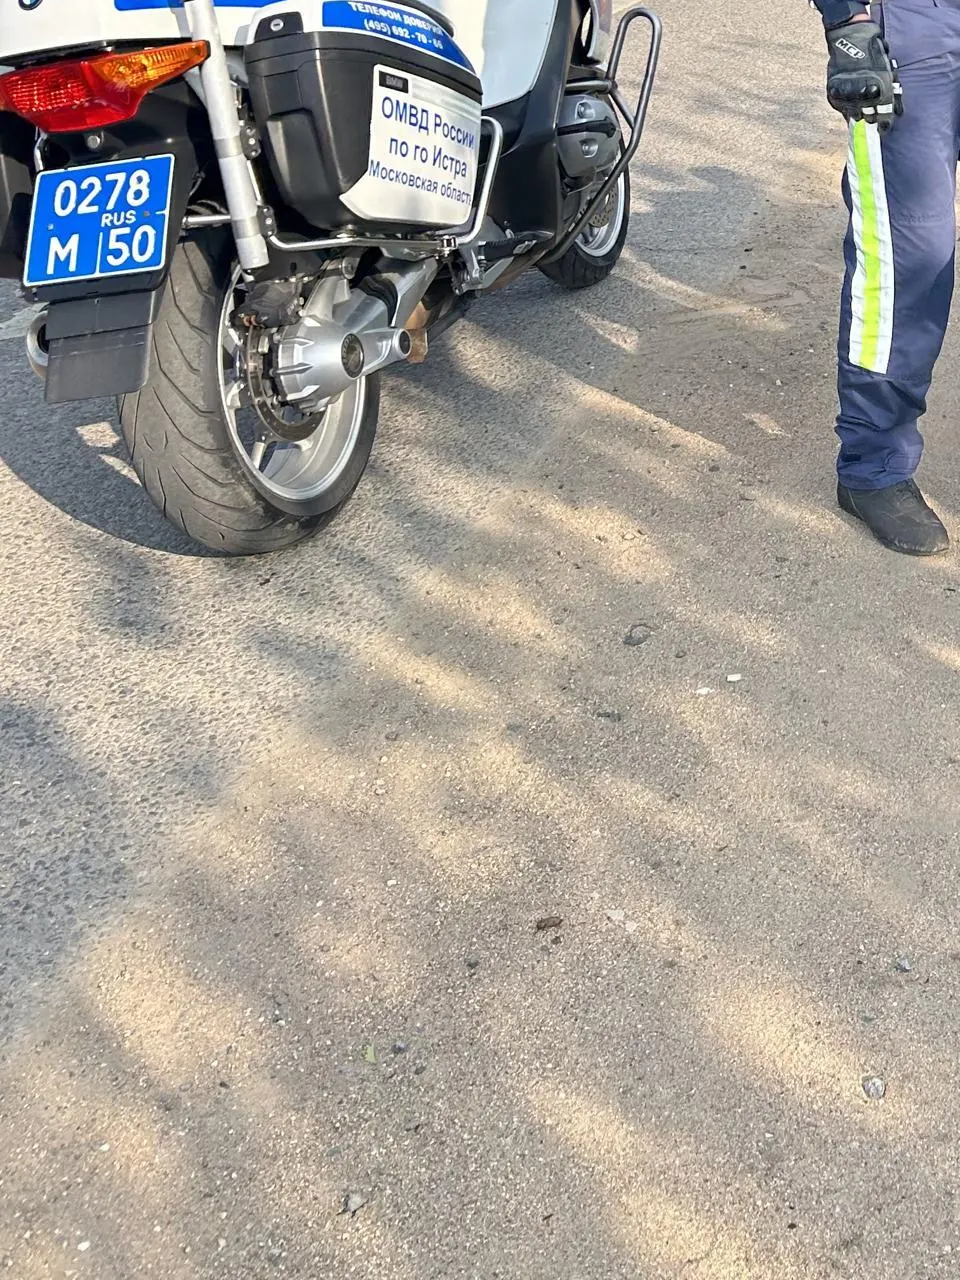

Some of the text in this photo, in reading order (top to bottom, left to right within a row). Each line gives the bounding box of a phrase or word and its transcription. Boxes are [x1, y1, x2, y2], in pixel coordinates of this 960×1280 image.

[348, 1, 402, 21] ТЕЛЕФОН
[364, 19, 391, 36] (495)
[381, 96, 475, 149] ОМВД России
[368, 159, 439, 194] Московская
[389, 137, 468, 180] по го Истра
[54, 169, 150, 217] 0278
[101, 210, 136, 227] RUS
[46, 225, 156, 275] М 50
